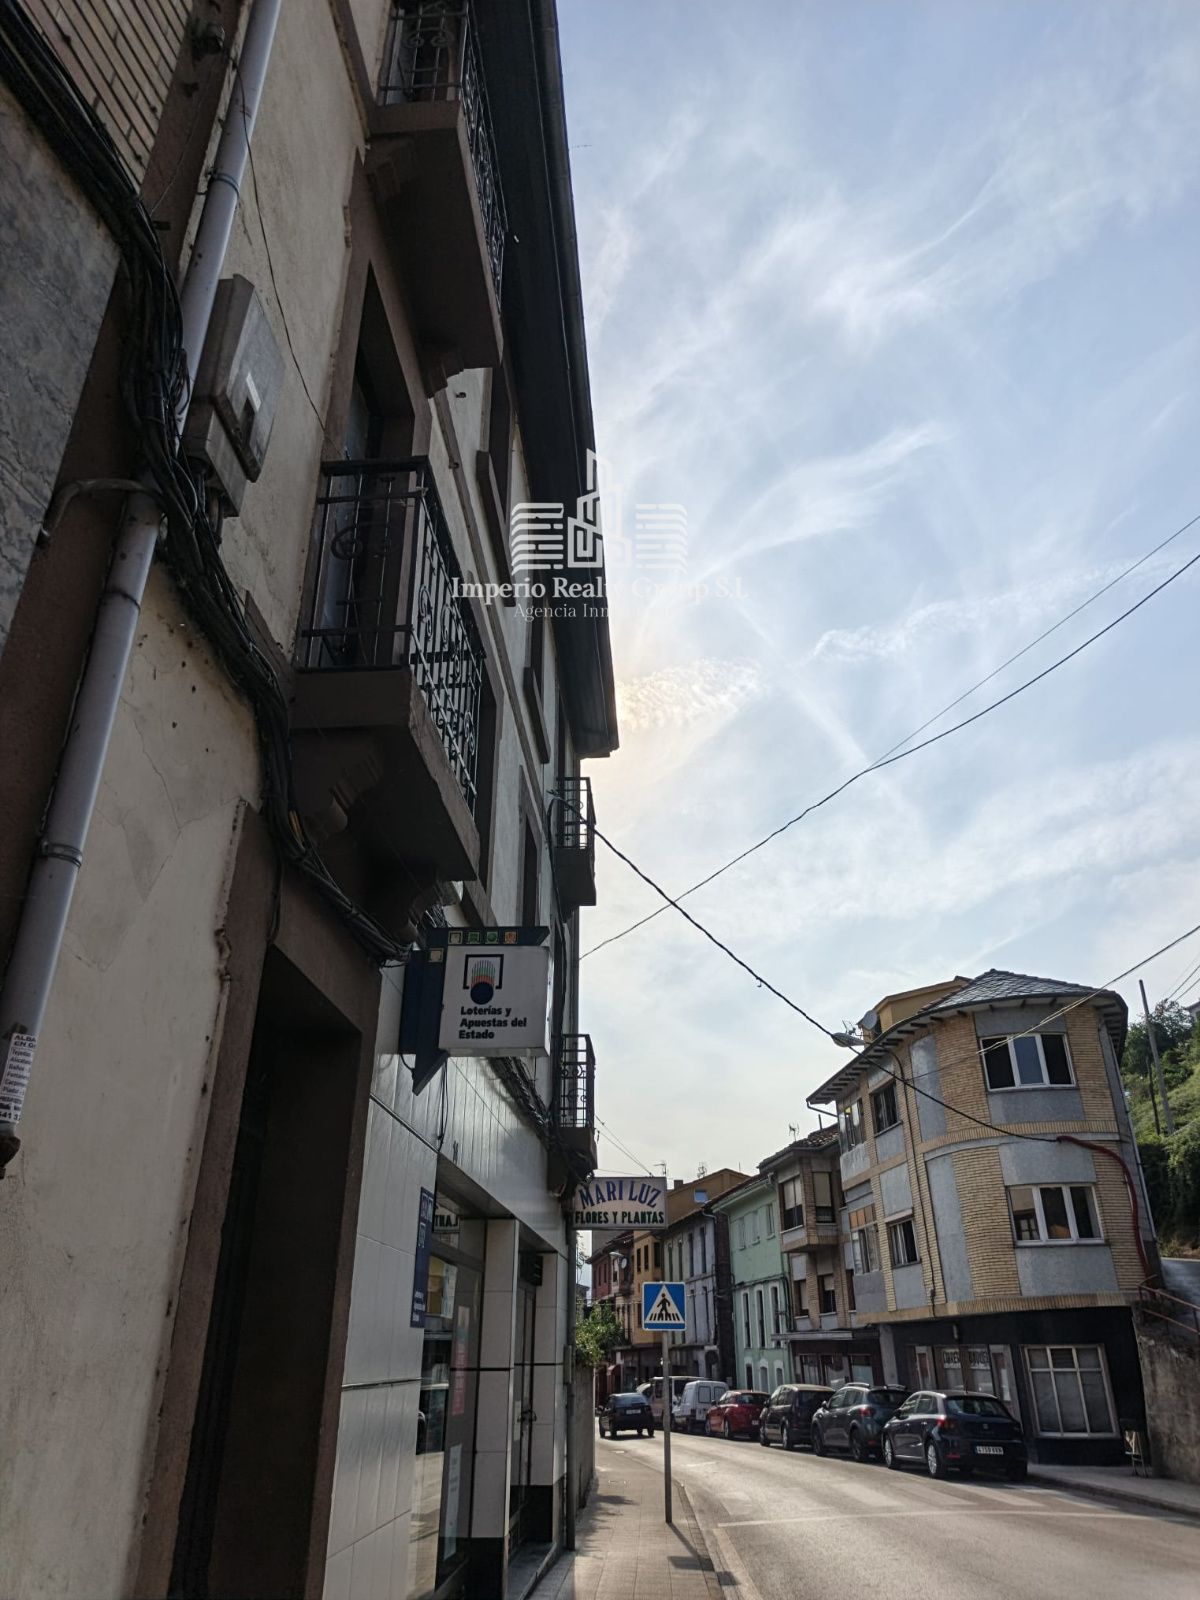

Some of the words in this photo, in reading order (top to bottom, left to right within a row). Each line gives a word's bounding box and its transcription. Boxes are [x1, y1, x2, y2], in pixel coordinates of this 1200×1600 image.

[460, 1006, 502, 1016] Loterías
[505, 1007, 512, 1017] y
[459, 1018, 508, 1029] Apuestas
[511, 1017, 527, 1028] del
[458, 1030, 495, 1040] Estado
[578, 1180, 623, 1210] MARI
[629, 1181, 662, 1208] LUZ
[575, 1211, 609, 1224] FLORES
[612, 1211, 618, 1224] Y
[621, 1211, 664, 1224] PLANTAS
